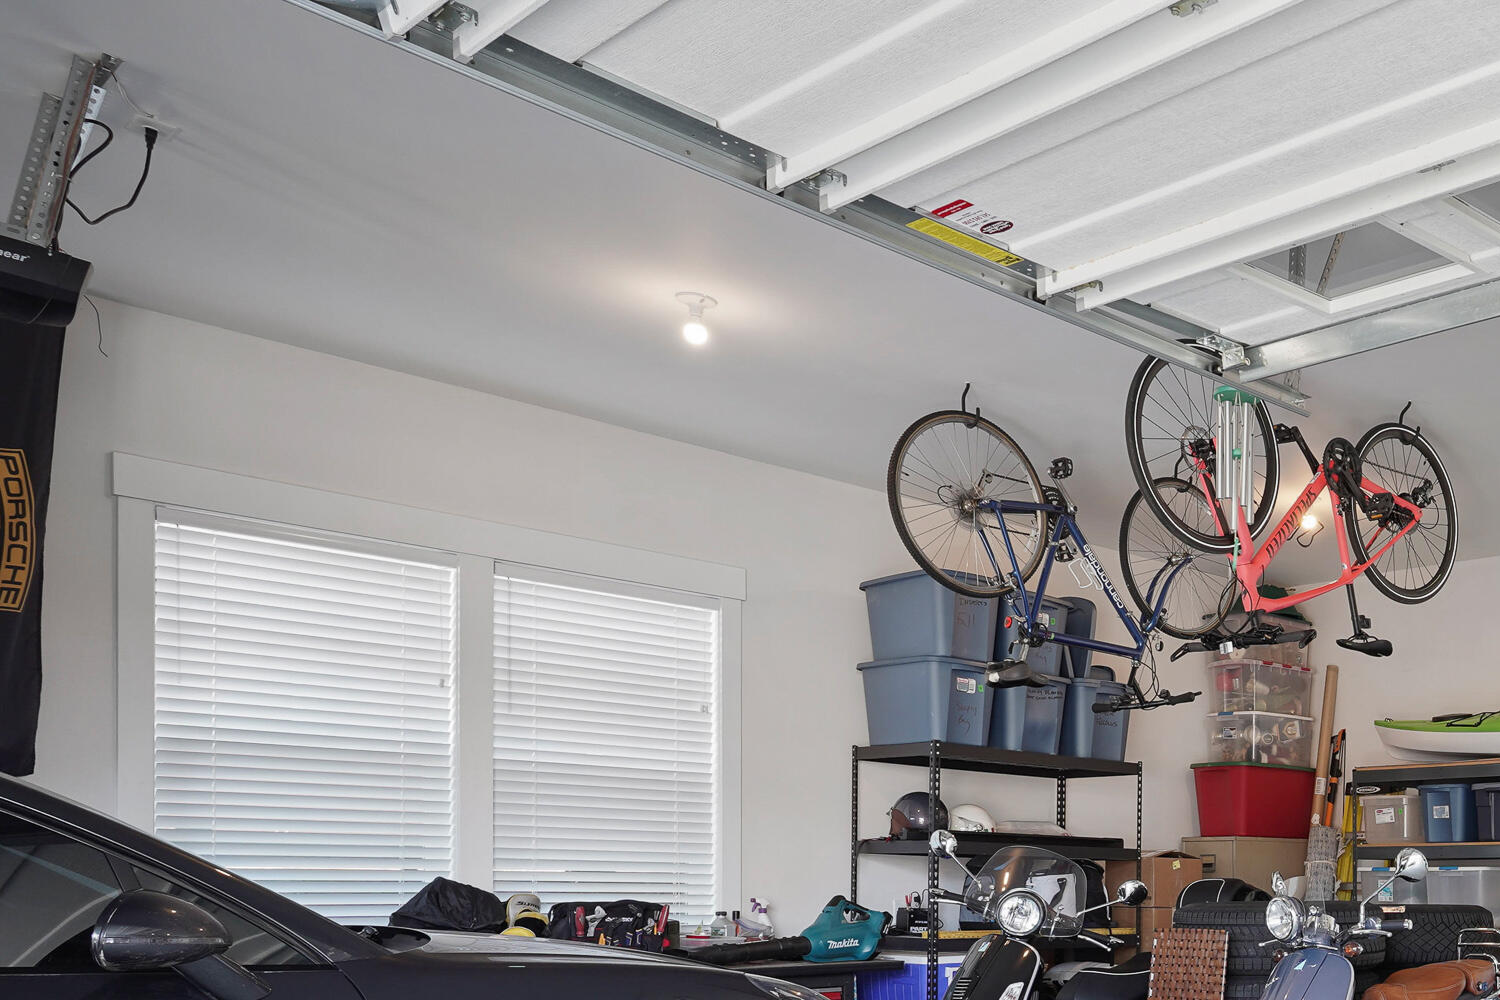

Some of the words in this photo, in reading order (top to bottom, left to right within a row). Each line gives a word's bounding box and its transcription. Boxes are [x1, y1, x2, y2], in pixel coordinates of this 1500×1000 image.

[0, 456, 28, 605] PORSCHE
[1265, 486, 1316, 560] SPECIALIZED
[1083, 543, 1124, 609] cannondale
[827, 938, 860, 950] Makita
